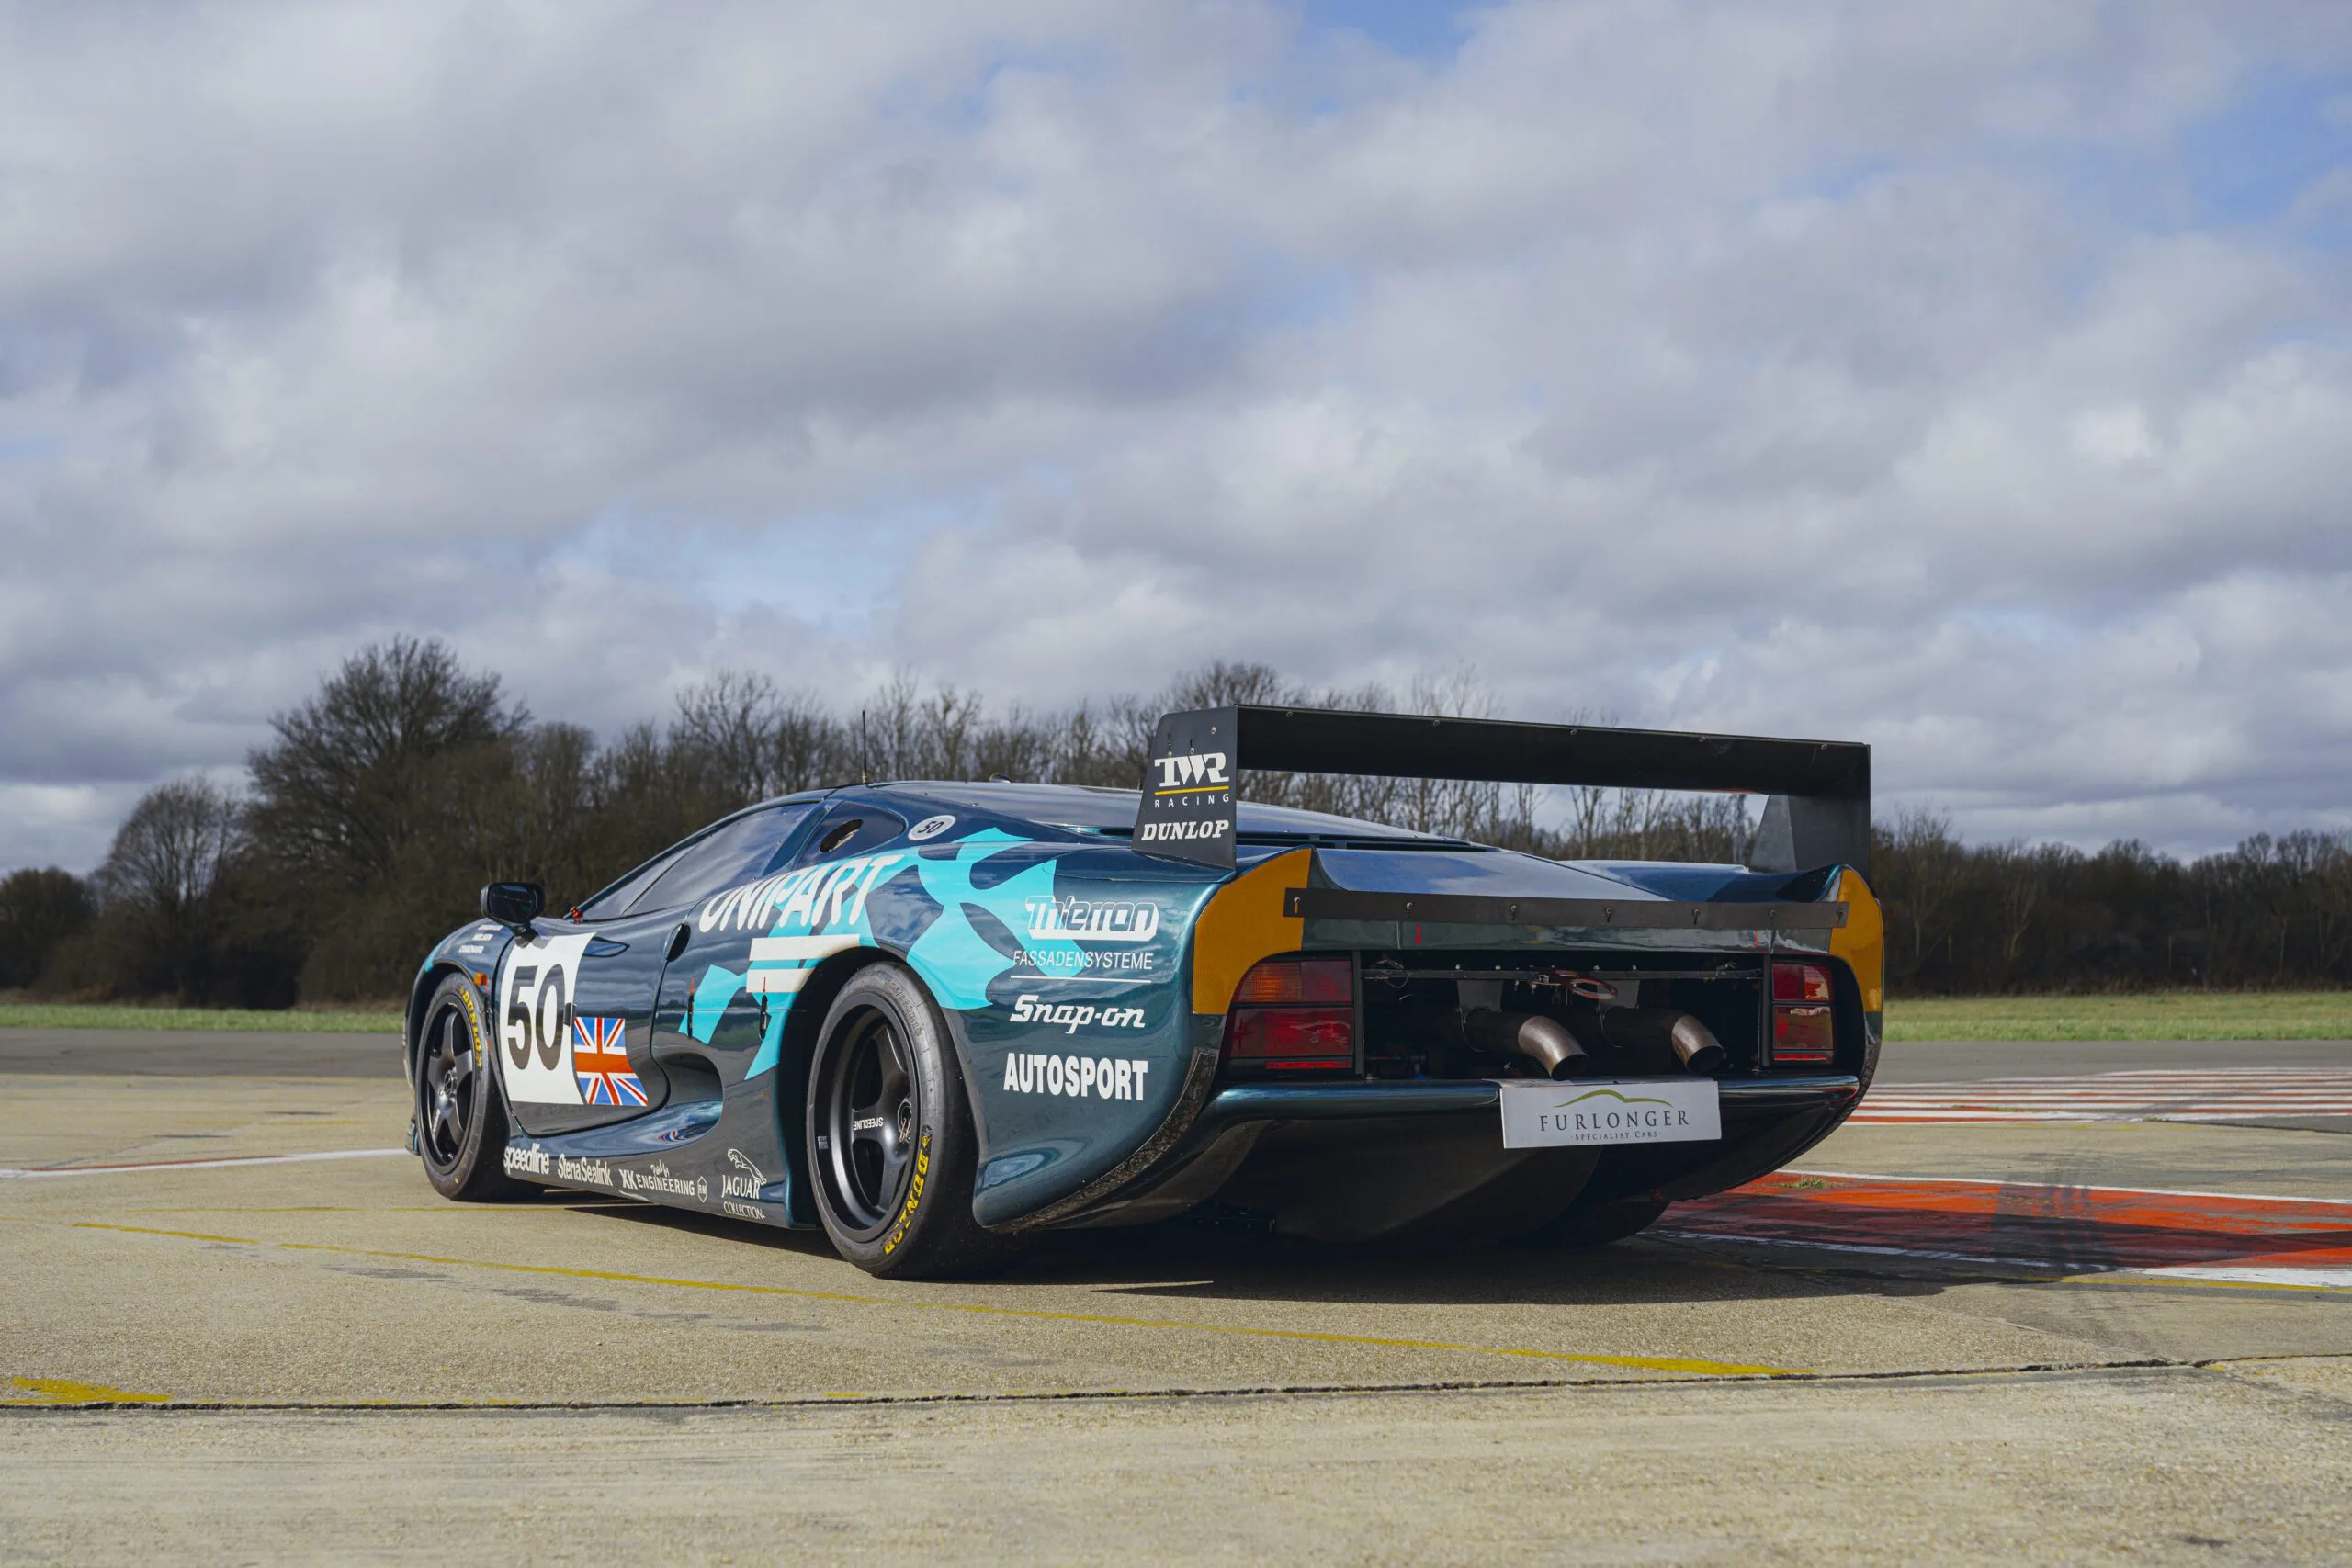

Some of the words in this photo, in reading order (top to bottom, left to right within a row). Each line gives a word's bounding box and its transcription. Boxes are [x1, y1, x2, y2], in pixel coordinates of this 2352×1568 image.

[1154, 752, 1229, 787] TWR
[1154, 793, 1229, 808] RACING
[917, 820, 945, 834] 50
[1140, 819, 1229, 841] DUNLOP
[698, 854, 905, 933] UNIPART
[1012, 950, 1154, 970] FASSADENSYSTEME
[507, 963, 566, 1071] 50
[1009, 994, 1146, 1034] Snap-on
[1003, 1052, 1148, 1101] AUTOSPORT
[853, 1117, 884, 1131] SPEEDLINE
[1539, 1110, 1690, 1132] FURLONGER
[503, 1142, 550, 1176] speedline
[618, 1168, 639, 1190] XK
[637, 1174, 695, 1197] ENGINEERING
[721, 1174, 762, 1200] JAGUAR
